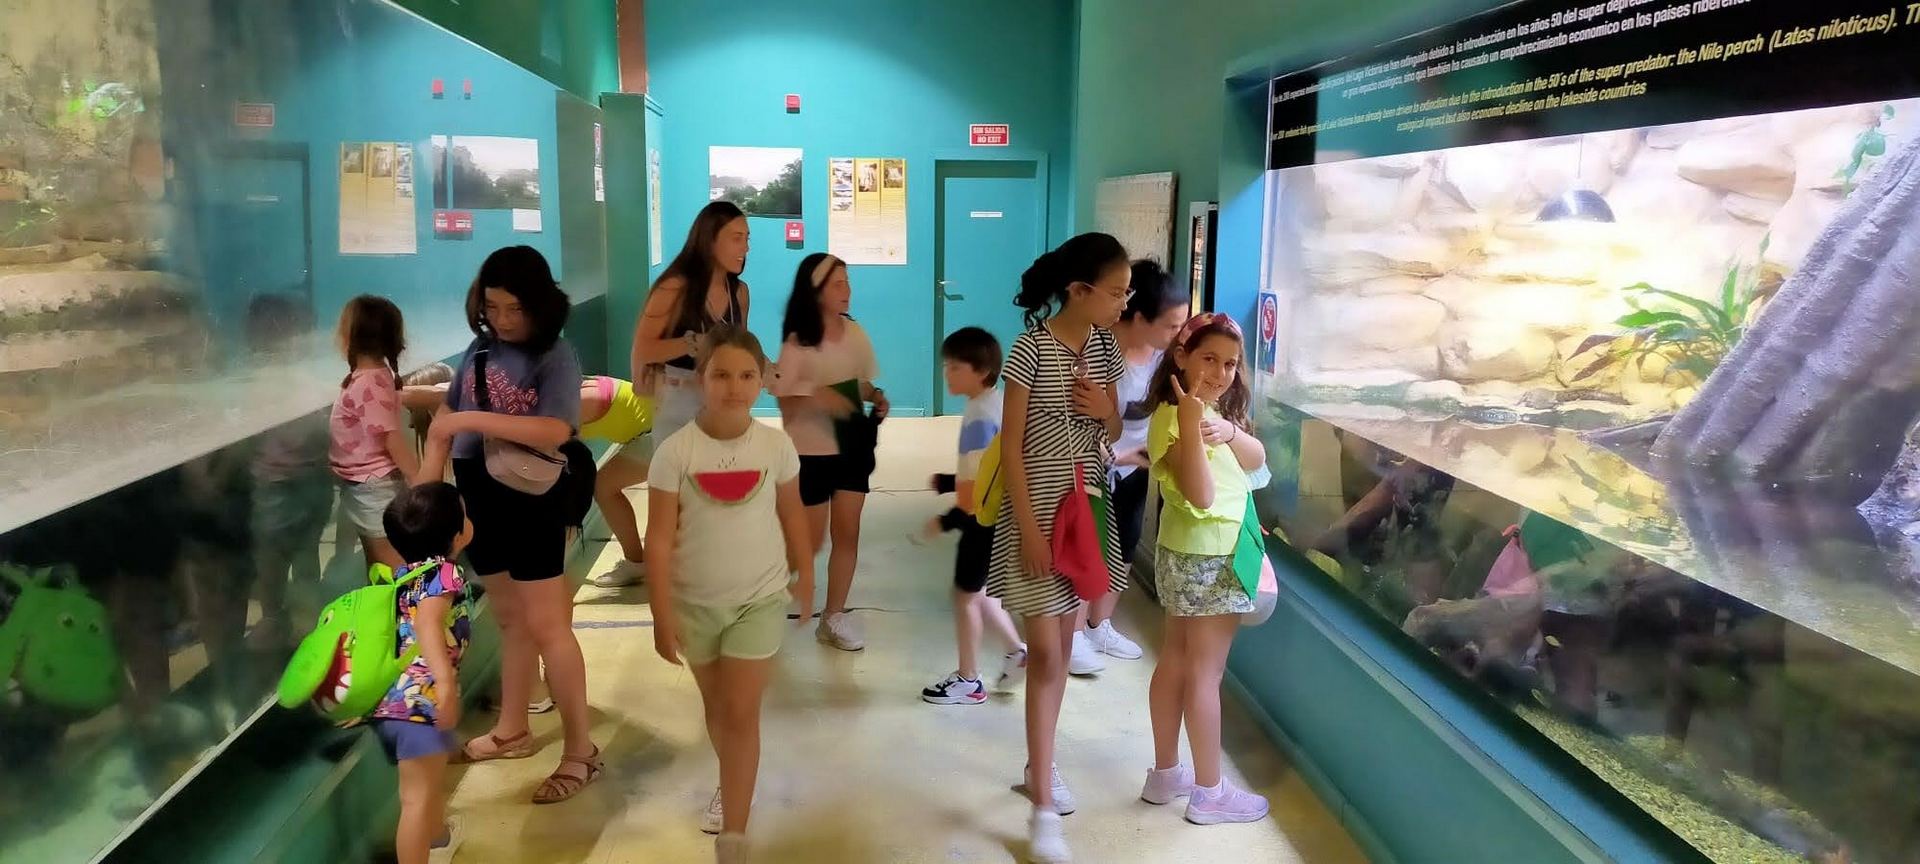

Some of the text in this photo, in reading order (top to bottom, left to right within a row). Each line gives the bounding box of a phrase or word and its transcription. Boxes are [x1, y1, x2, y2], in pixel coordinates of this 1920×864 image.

[1416, 69, 1426, 82] que
[1451, 60, 1460, 72] ha
[1460, 52, 1490, 70] causado
[1490, 51, 1500, 62] un
[1500, 32, 1568, 60] empobrecimiento
[1568, 21, 1620, 44] economico
[1621, 17, 1635, 32] en
[1636, 12, 1652, 28] los
[1428, 45, 1449, 60] debido
[1449, 45, 1455, 55] a
[1456, 40, 1463, 53] la
[1506, 28, 1516, 39] en
[1517, 23, 1530, 36] los
[1530, 18, 1550, 34] años
[1550, 12, 1562, 28] 50
[1563, 8, 1578, 24] del
[1578, 3, 1606, 22] super
[1461, 92, 1469, 104] to
[1469, 90, 1480, 102] the
[1480, 82, 1525, 100] introduction
[1525, 79, 1534, 93] in
[1534, 76, 1548, 92] the
[1568, 69, 1580, 85] of
[1579, 68, 1595, 83] the
[1595, 64, 1626, 82] super
[1623, 53, 1676, 78] predator:
[1676, 48, 1698, 66] the
[1698, 42, 1724, 62] Nile
[1722, 33, 1765, 62] perch
[1768, 26, 1816, 54] (Lates
[1816, 8, 1898, 41] niloticus).
[1470, 103, 1506, 120] economic
[1505, 99, 1534, 115] decline
[1534, 98, 1546, 110] on
[1545, 94, 1560, 109] the
[1560, 88, 1599, 106] lakeside
[1598, 80, 1648, 101] countries
